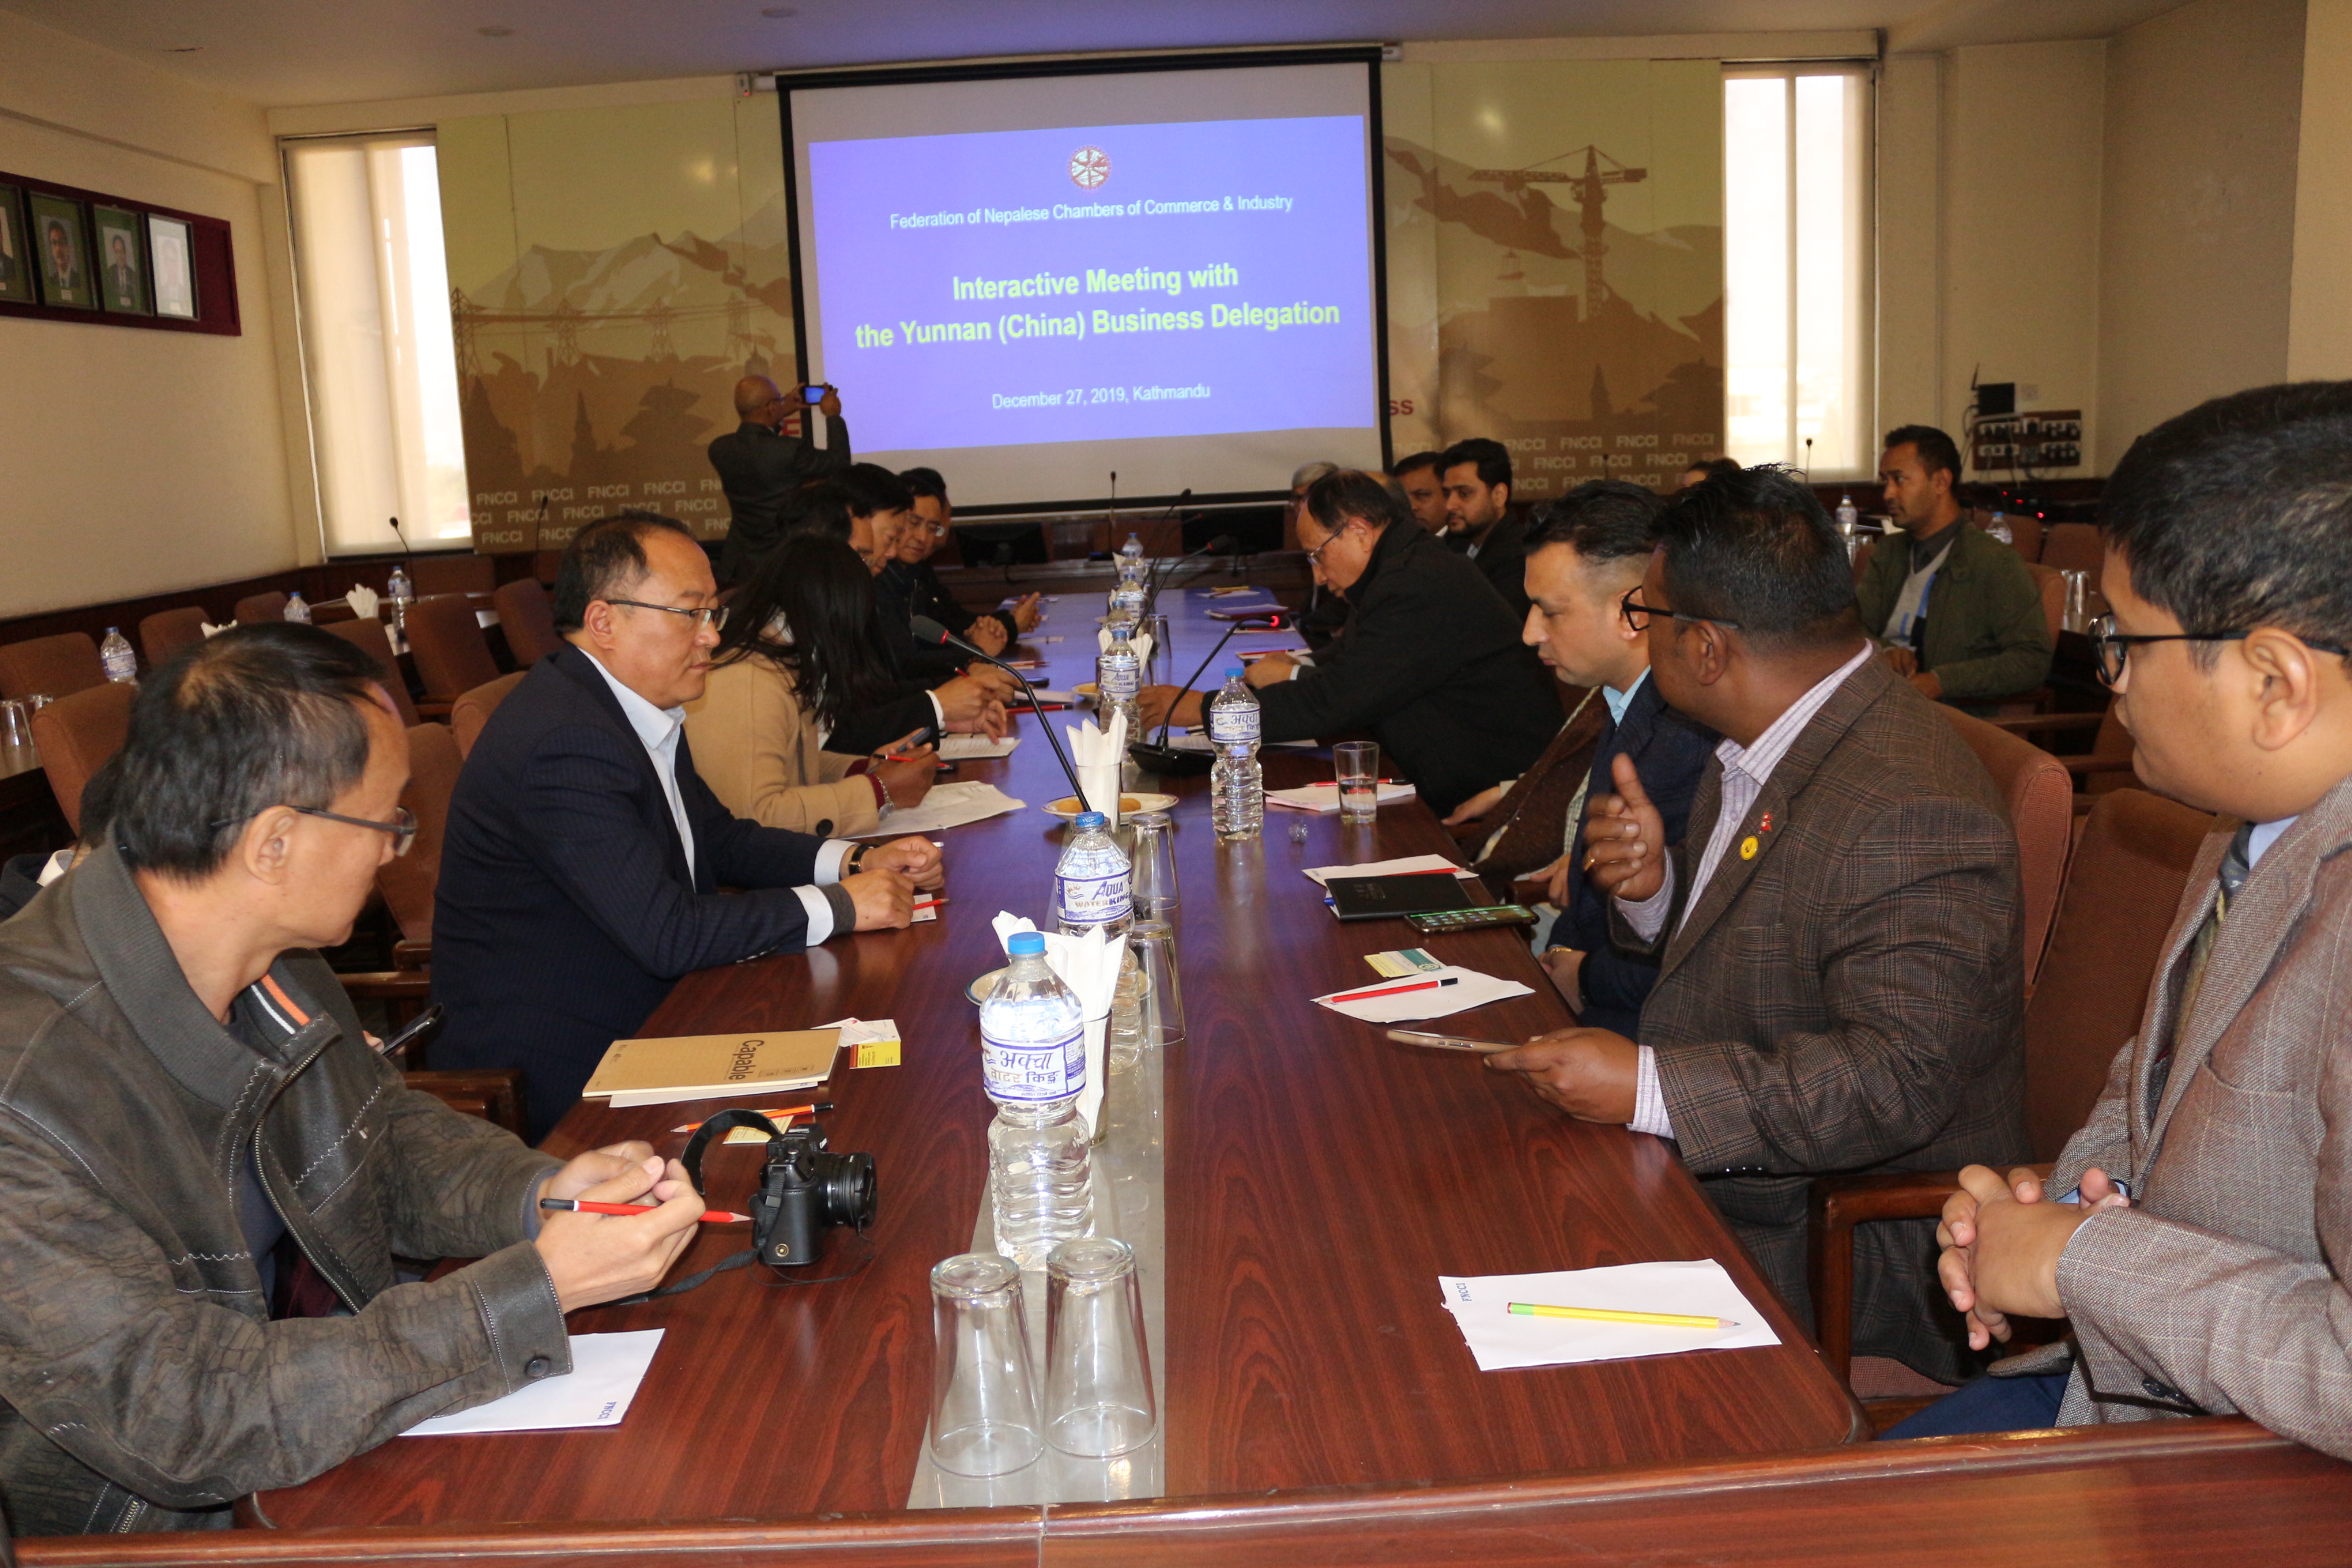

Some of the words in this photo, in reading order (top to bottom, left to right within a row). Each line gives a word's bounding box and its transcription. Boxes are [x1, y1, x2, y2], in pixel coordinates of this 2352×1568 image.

[889, 210, 964, 229] Federation
[967, 208, 982, 224] of
[984, 206, 1049, 226] Nepalese
[1053, 203, 1124, 220] Chambers
[1127, 200, 1141, 216] of
[1144, 198, 1220, 215] Commerce
[1223, 196, 1233, 211] &
[1238, 195, 1292, 213] Industry
[953, 272, 1079, 300] Interactive
[1086, 266, 1181, 295] Meeting
[1188, 262, 1239, 288] with
[855, 323, 894, 348] the
[899, 320, 992, 344] Yunnan
[998, 310, 1085, 345] (China)
[1092, 308, 1204, 333] Business
[1211, 301, 1340, 331] Delegation
[992, 391, 1062, 408] December
[1066, 389, 1087, 406] 27,
[1091, 387, 1130, 404] 2019,
[1133, 382, 1211, 401] Kathmandu
[1561, 436, 1602, 450] FNCCI
[1616, 434, 1659, 447] FNCCI
[1673, 433, 1714, 446] FNCCI
[1534, 456, 1575, 470] FNCCI
[1646, 453, 1688, 466] FNCCI
[476, 491, 518, 506] FNCCI
[587, 485, 629, 498] FNCCI
[644, 480, 686, 495] FNCCI
[507, 509, 549, 523] FNCCI
[563, 505, 604, 520] FNCCI
[675, 499, 717, 512] FNCCI
[482, 531, 523, 544] FNCCI
[1075, 900, 1109, 908] WATER
[1109, 892, 1129, 905] KING
[1092, 881, 1123, 900] AQUA
[729, 1040, 764, 1080] Capable
[1000, 1050, 1054, 1070] अक्वा
[991, 1067, 1023, 1083] वाटर
[1456, 1282, 1472, 1301] FNCCI
[597, 1401, 617, 1420] FNCCI
